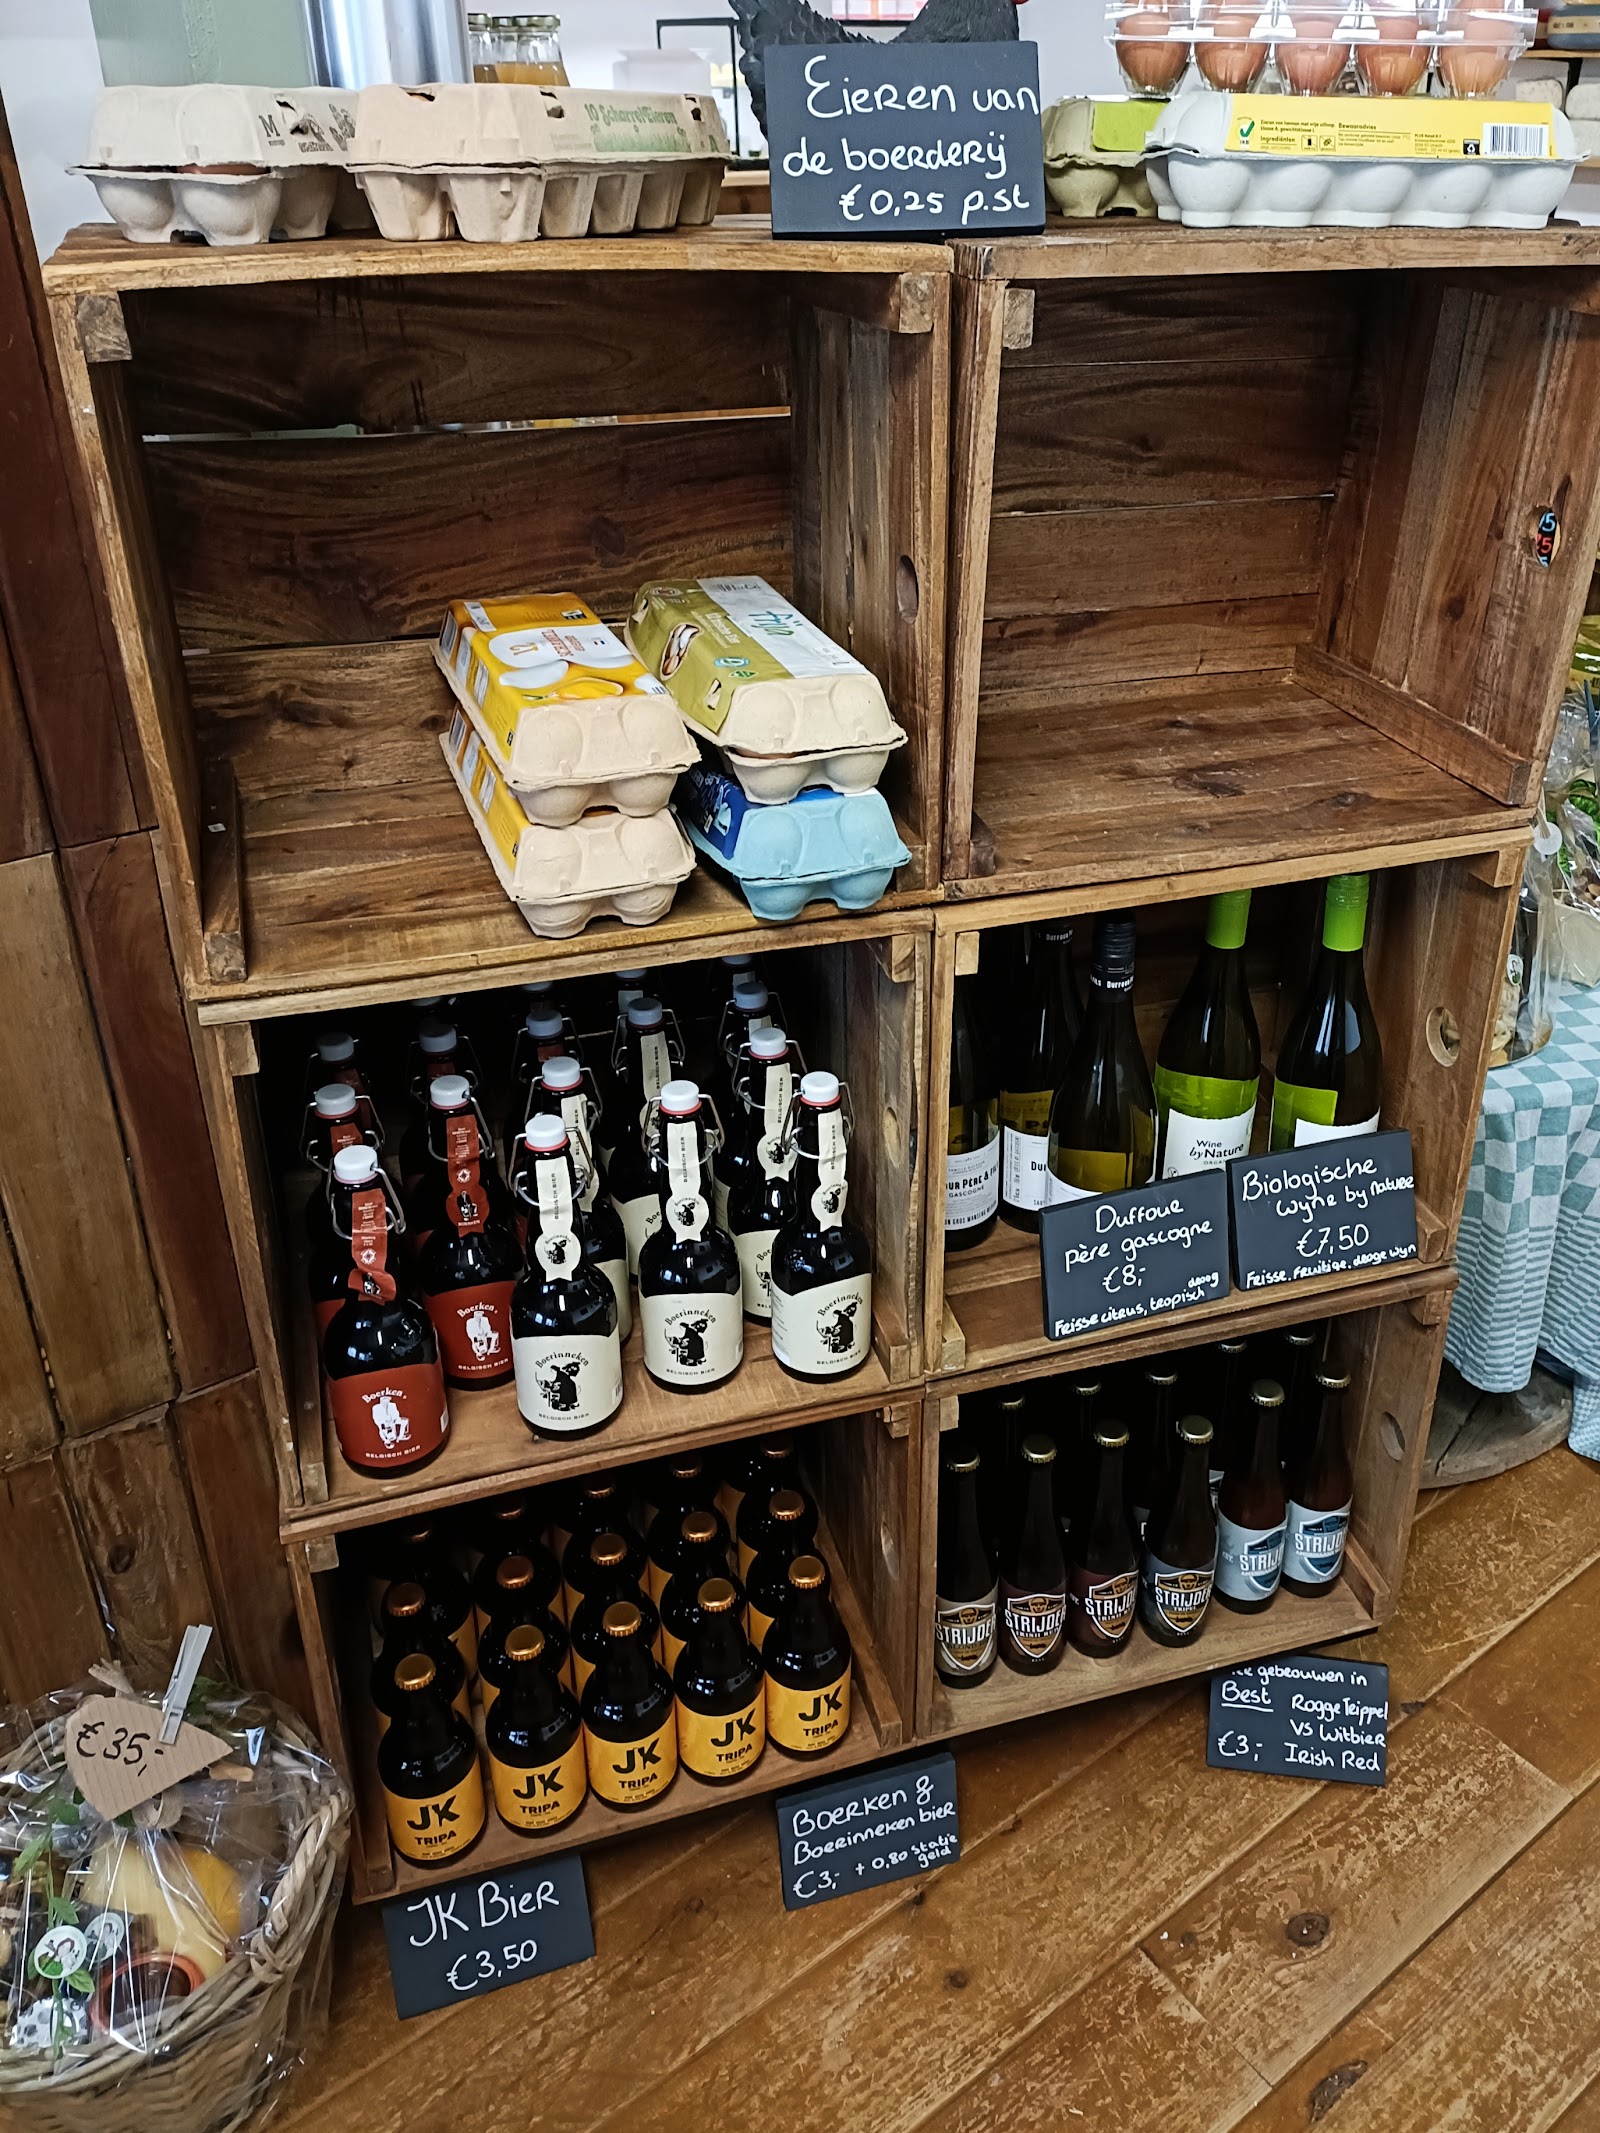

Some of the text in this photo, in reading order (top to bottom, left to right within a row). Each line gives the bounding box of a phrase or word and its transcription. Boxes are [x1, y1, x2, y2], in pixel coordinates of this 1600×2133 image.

[804, 55, 1040, 118] Eieren van
[782, 131, 1008, 180] de boerderij
[1189, 1143, 1245, 1161] by Nature
[1196, 1139, 1223, 1149] Wine
[949, 1184, 985, 1198] GASCOGNE
[1242, 1158, 1378, 1202] Biologische
[1344, 1186, 1369, 1209] by
[1120, 1220, 1213, 1262] gascogne
[1296, 1223, 1370, 1258] €7,50
[458, 1357, 509, 1371] BELGISCH BIER
[666, 1367, 716, 1376] BELGISCH BIER
[538, 1412, 590, 1421] BELGISCH BIER
[365, 1445, 421, 1459] BELGISCH BIER
[1350, 1671, 1368, 1687] in
[797, 1683, 843, 1722] JK
[1221, 1680, 1272, 1705] Best
[710, 1708, 757, 1748] JK
[802, 1718, 840, 1737] TRIPA
[612, 1737, 662, 1775] JK
[715, 1743, 753, 1763] TRIPA
[1283, 1742, 1381, 1772] Irish Red
[512, 1765, 564, 1800] JK
[618, 1772, 659, 1789] TRIPA
[406, 1794, 460, 1831] JK
[519, 1800, 561, 1815] TRIPA
[793, 1775, 935, 1838] Boerken &
[414, 1829, 458, 1846] TRIPA
[793, 1801, 957, 1866] Boerinneken bier
[855, 1863, 865, 1876] +
[871, 1850, 909, 1870] 0,80
[917, 1846, 952, 1869] geld
[407, 1880, 560, 1947] JK Bier
[446, 1939, 538, 1991] €3,50
